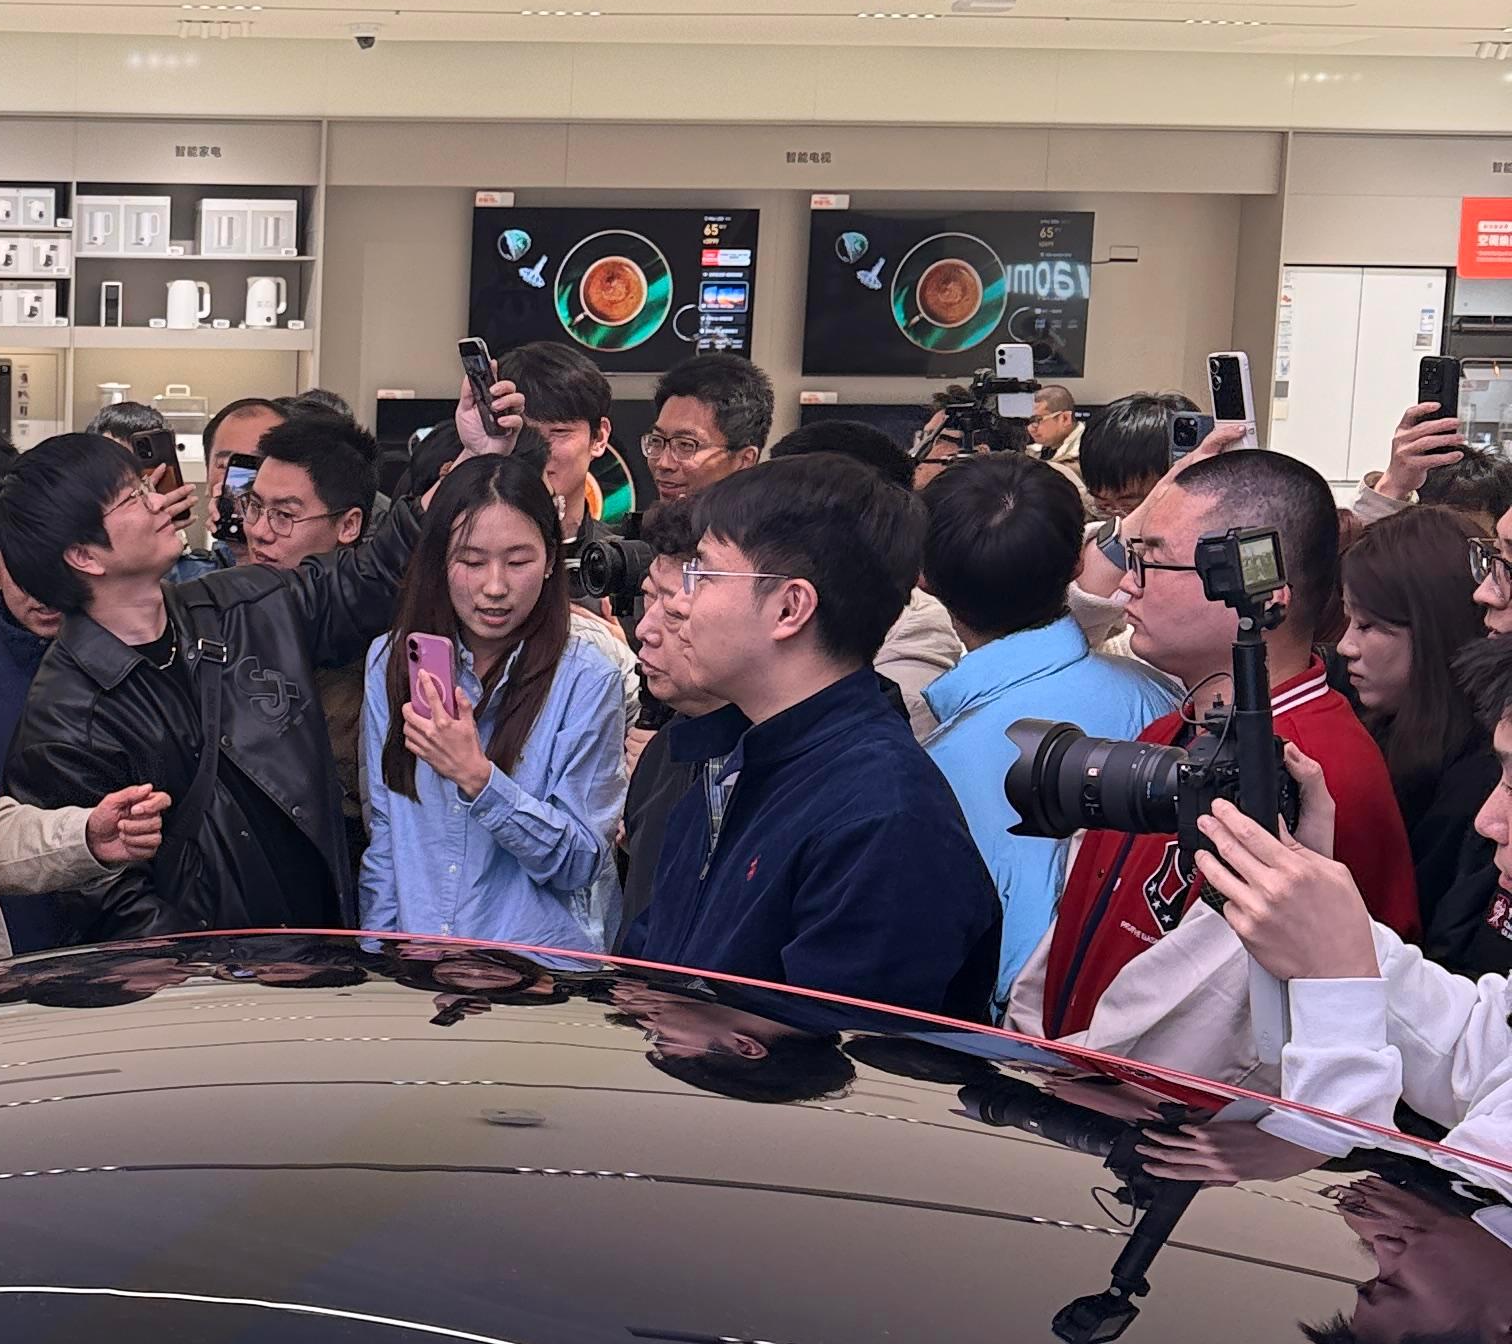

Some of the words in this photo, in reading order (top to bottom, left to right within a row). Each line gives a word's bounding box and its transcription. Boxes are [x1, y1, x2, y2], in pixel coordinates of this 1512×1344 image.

[785, 151, 832, 164] 智能电视
[703, 223, 719, 236] 65
[1039, 226, 1054, 239] 65
